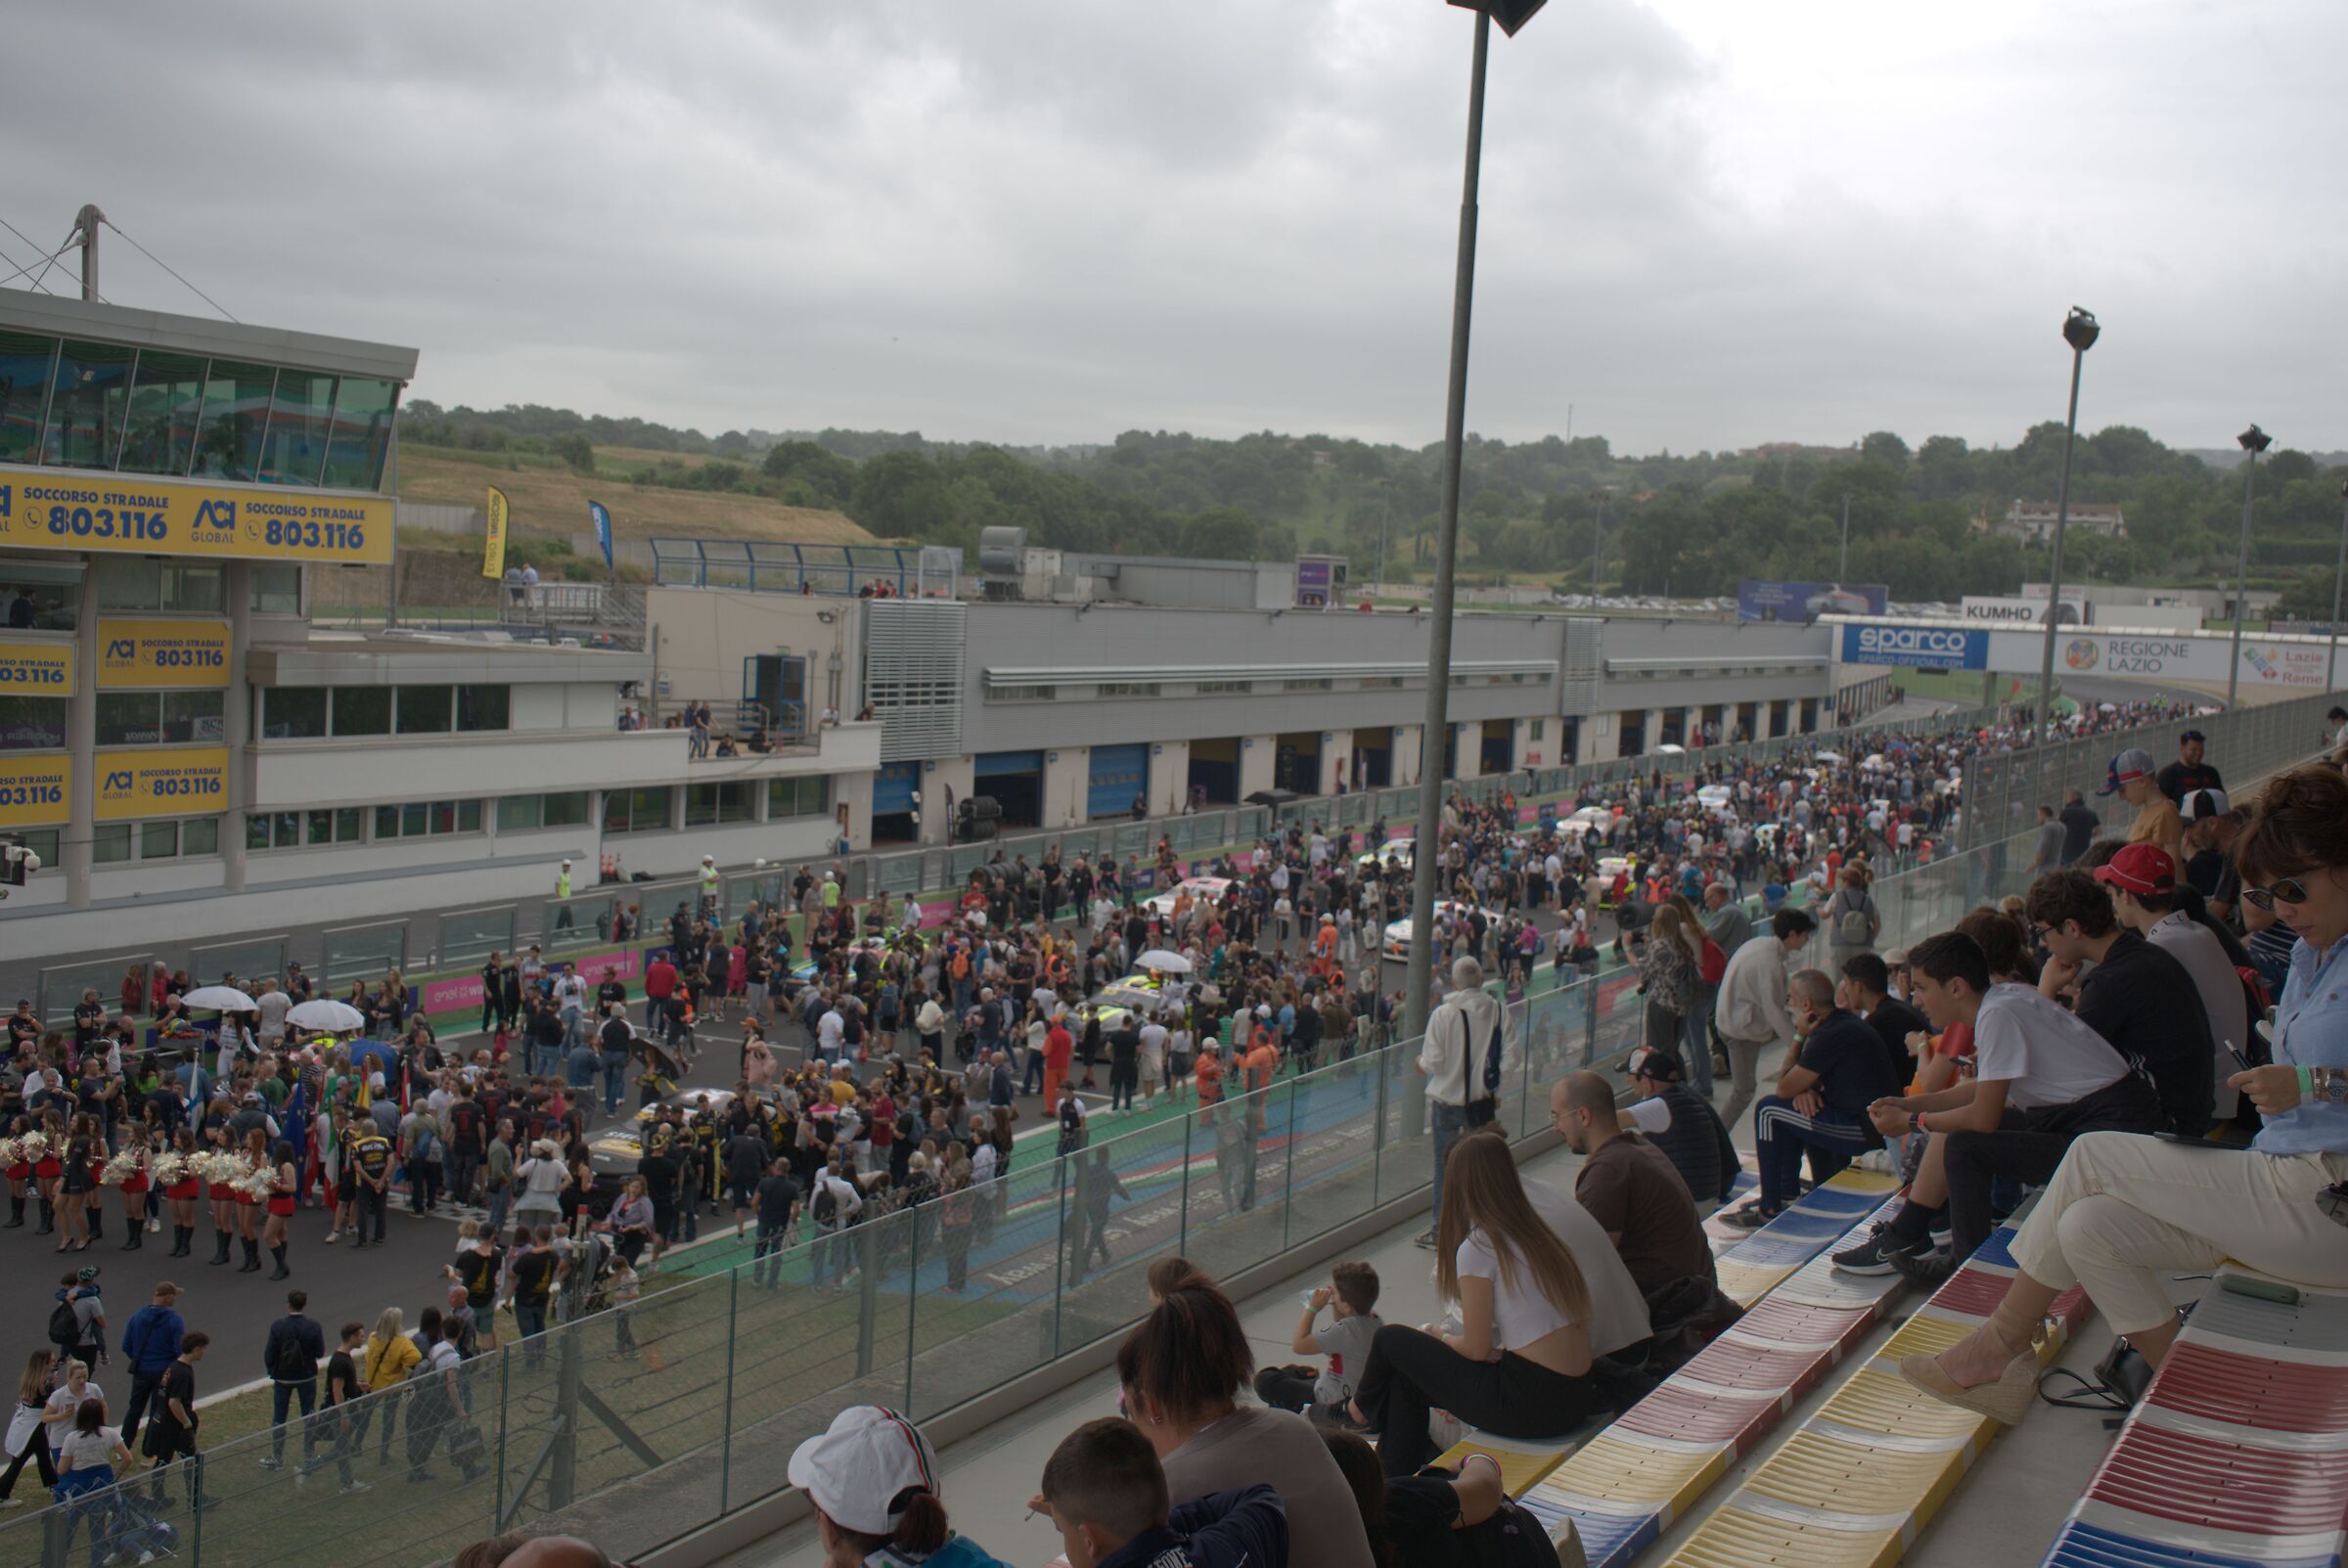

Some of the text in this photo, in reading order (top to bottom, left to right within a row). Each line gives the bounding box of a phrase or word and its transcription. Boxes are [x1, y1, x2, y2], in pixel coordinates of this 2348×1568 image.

[24, 487, 98, 504] SOCCORSO
[104, 492, 168, 509] STRADALE
[192, 499, 236, 530] ACI
[246, 502, 365, 520] SOCCORSO STRADALE
[48, 506, 167, 540] 803.116
[191, 531, 235, 544] GLOBAL
[265, 519, 364, 550] 803.116
[1967, 605, 2032, 621] KUMHO
[1859, 626, 1965, 653] sparco
[106, 640, 135, 658] ACI
[2109, 641, 2190, 658] REGIONE
[155, 650, 224, 667] 803.116
[2108, 657, 2163, 673] LAZIO
[0, 667, 65, 683] 03.116
[19, 775, 63, 784] STRADALE
[104, 771, 133, 790] ACI
[139, 767, 222, 778] SOCCORSO STRADALE
[0, 784, 62, 806] 03.116
[153, 778, 221, 796] 803.116
